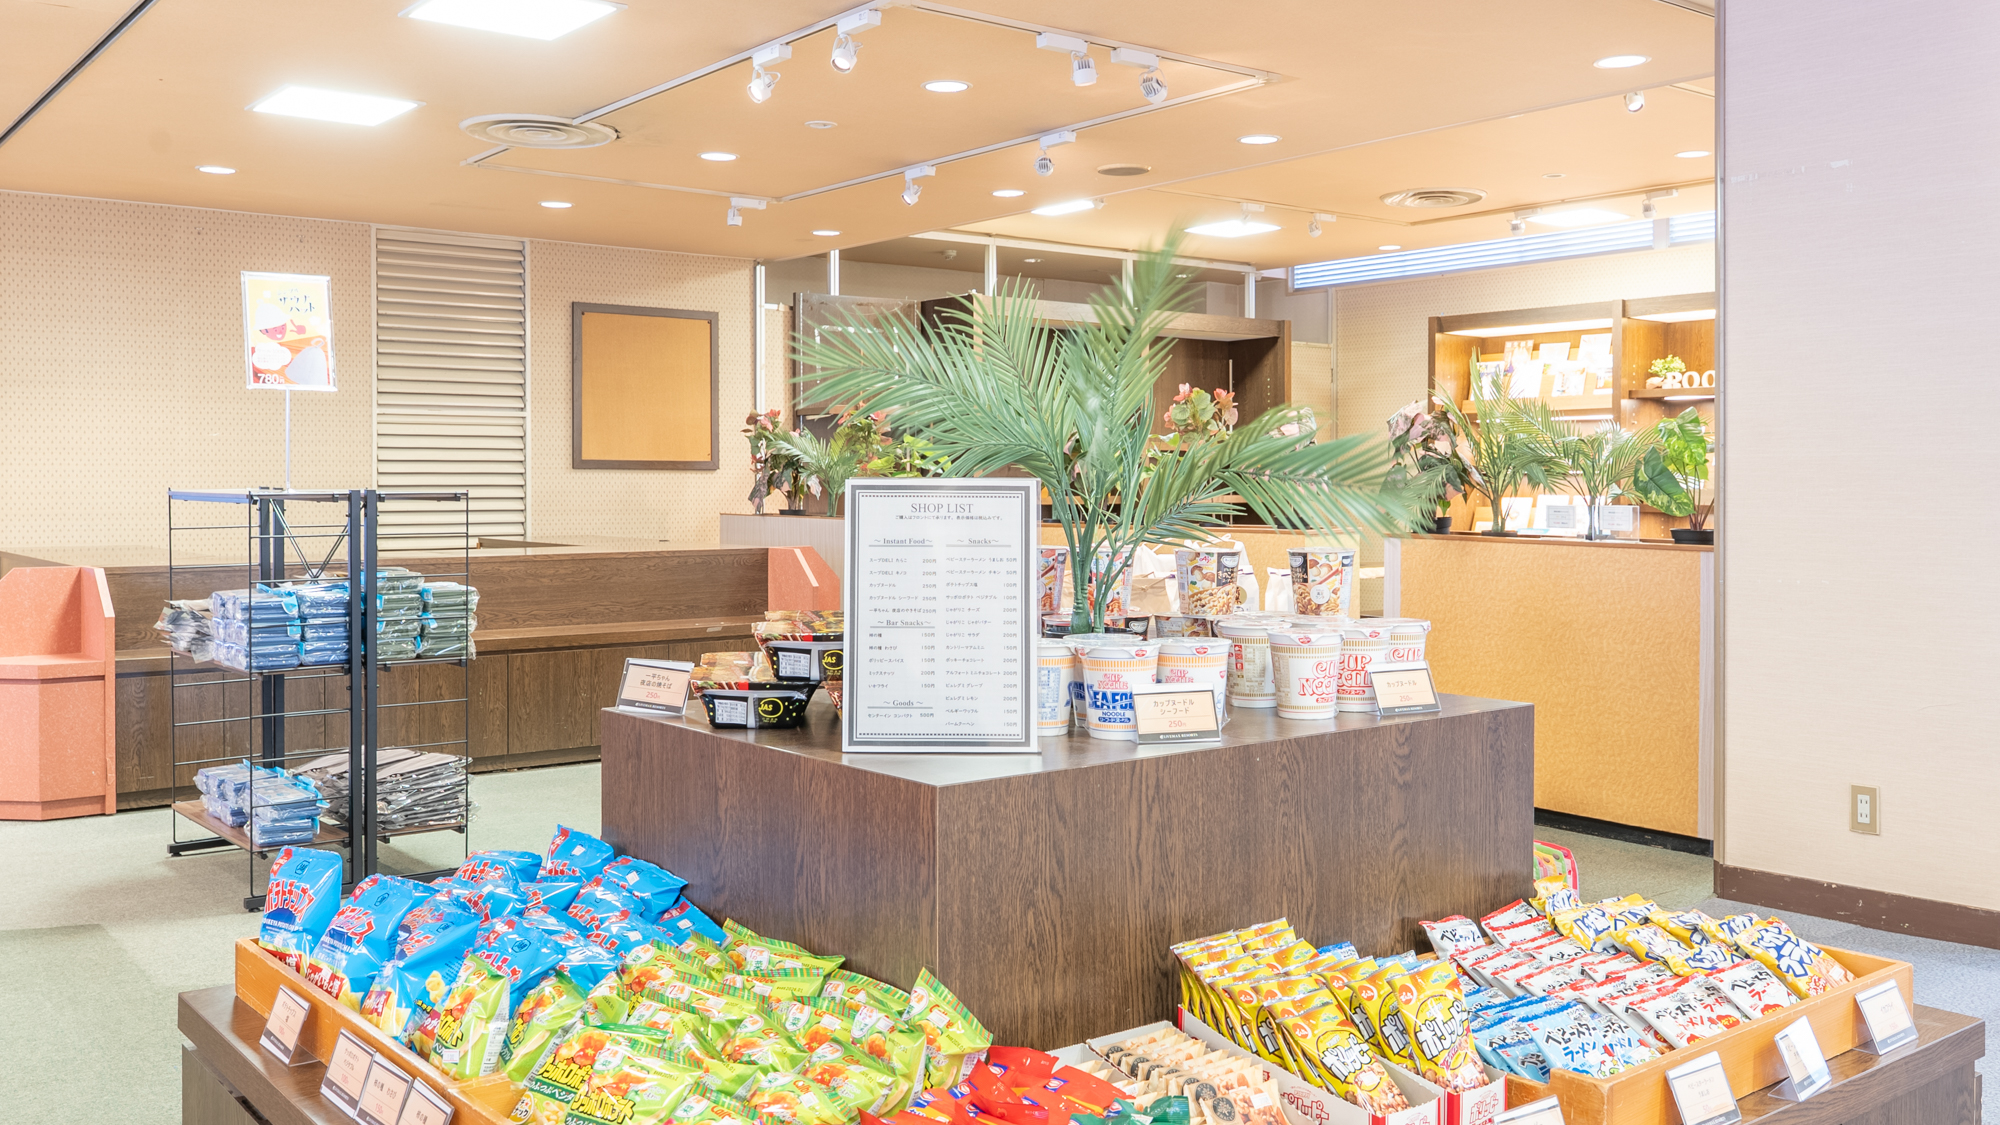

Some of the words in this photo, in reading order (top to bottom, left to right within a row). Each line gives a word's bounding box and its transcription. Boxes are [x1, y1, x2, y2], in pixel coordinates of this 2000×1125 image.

[911, 503, 943, 513] SHOP
[947, 503, 973, 513] LIST
[646, 673, 670, 681] 一平ちゃん
[1153, 699, 1194, 707] カップヌードル
[1160, 707, 1190, 715] シーフード
[1562, 1041, 1597, 1063] ラーメン
